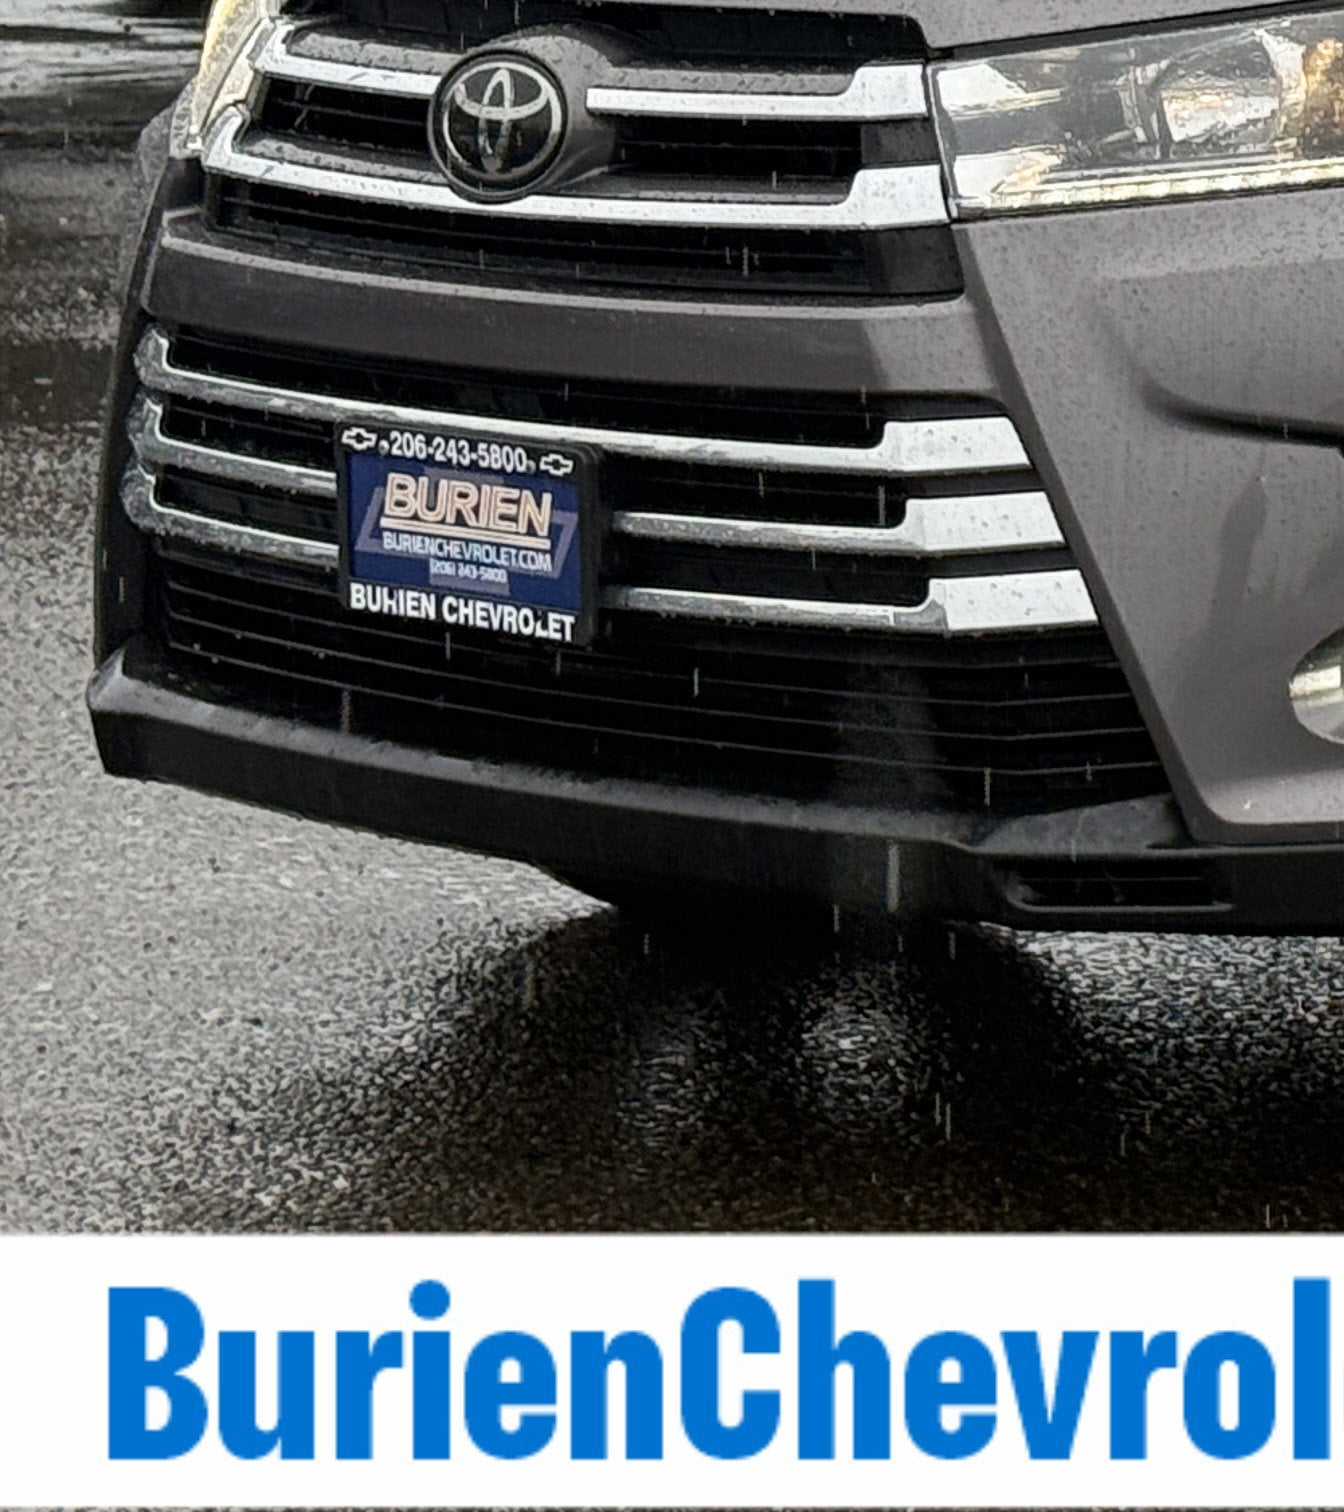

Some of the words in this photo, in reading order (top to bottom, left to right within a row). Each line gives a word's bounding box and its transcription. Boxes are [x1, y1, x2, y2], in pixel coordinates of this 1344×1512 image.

[390, 431, 528, 473] 206-243-5800
[384, 472, 552, 537] BURIEN
[382, 531, 553, 572] BURIENCHEVROLET.COM
[442, 595, 576, 642] CHEVROLET
